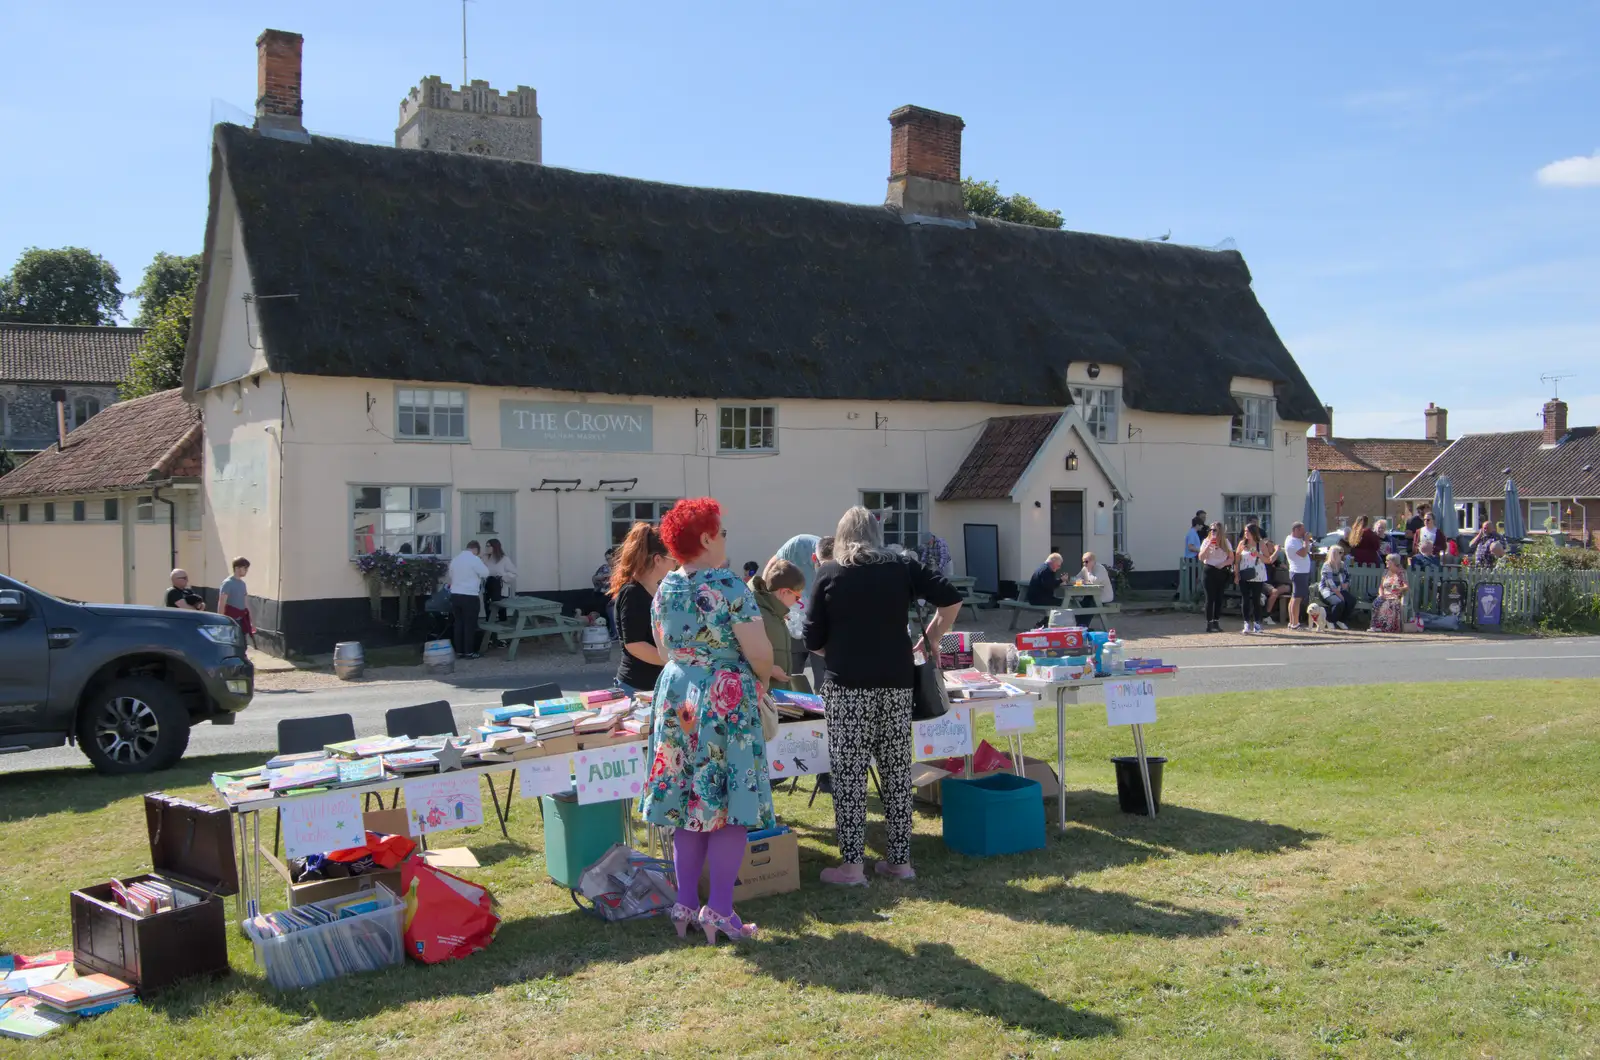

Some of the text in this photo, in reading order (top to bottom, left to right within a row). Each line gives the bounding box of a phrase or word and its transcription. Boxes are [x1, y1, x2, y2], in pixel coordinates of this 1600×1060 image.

[513, 410, 642, 432] THE CROWN
[588, 758, 638, 783] ADULT
